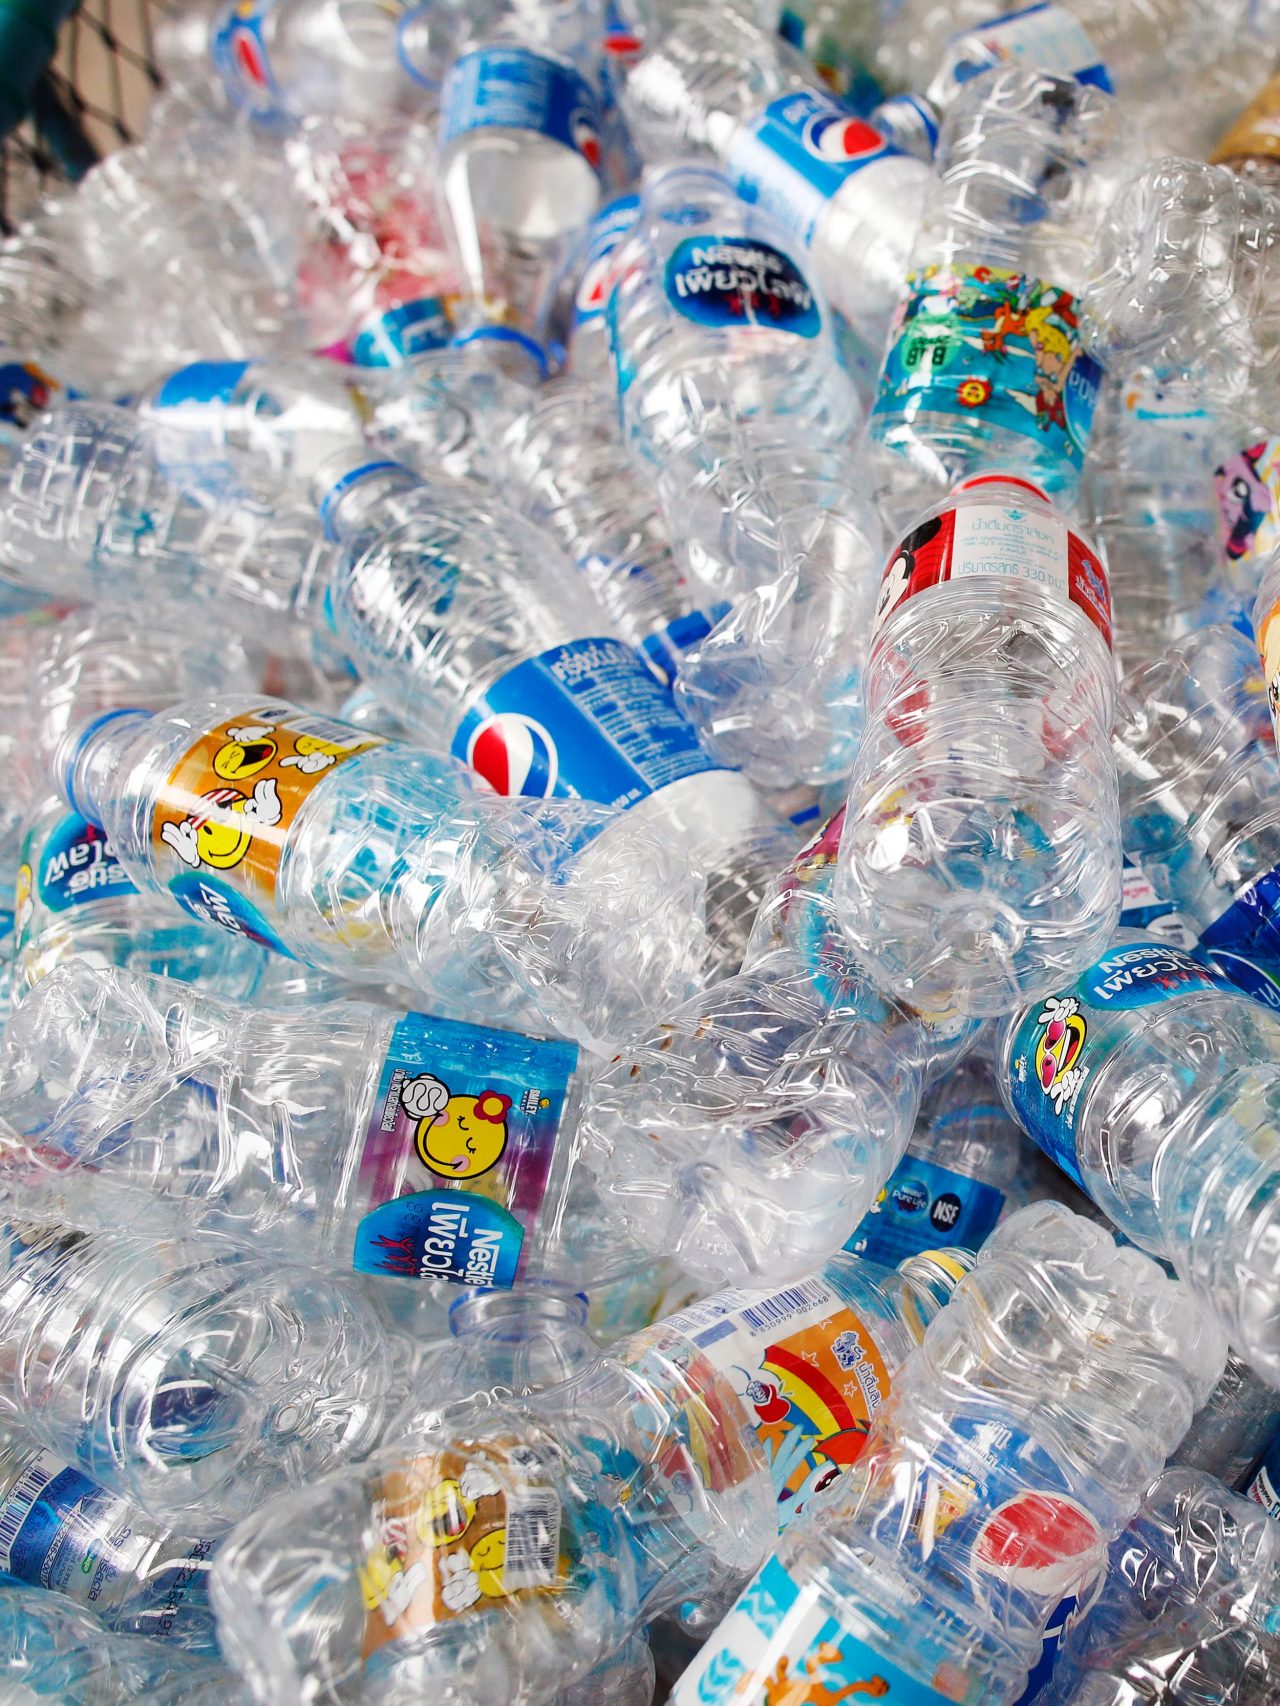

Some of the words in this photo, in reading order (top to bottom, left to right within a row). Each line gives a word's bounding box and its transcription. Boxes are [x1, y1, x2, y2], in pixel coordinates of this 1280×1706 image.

[1023, 565, 1046, 582] 330
[524, 1088, 541, 1116] SMILEY
[932, 1200, 960, 1225] NSF
[750, 1330, 757, 1338] 8
[760, 1313, 793, 1334] 850999
[796, 1295, 830, 1316] 002668
